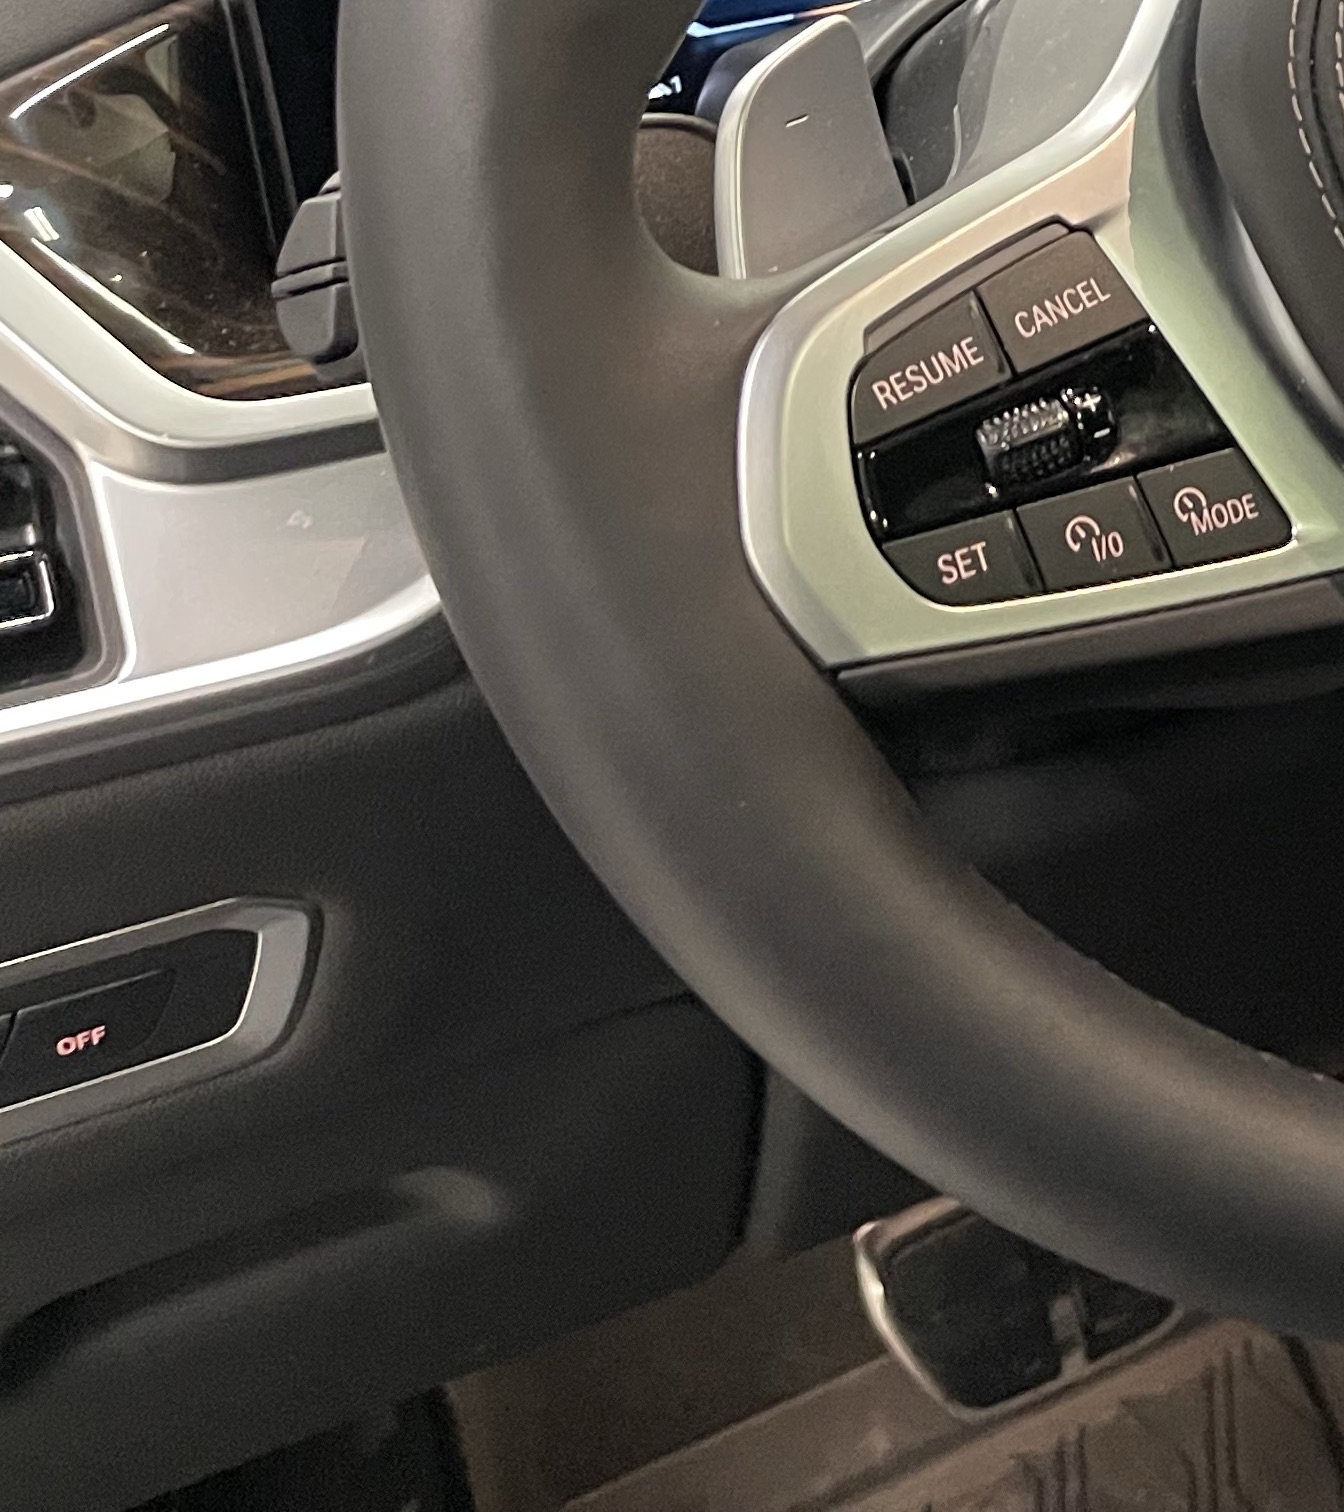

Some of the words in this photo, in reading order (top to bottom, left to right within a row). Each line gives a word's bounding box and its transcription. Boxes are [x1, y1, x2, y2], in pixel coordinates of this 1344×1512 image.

[1014, 277, 1112, 339] CANCEL
[872, 336, 985, 411] RESUME
[1190, 492, 1260, 537] MODE
[937, 542, 989, 585] SET
[56, 1024, 106, 1057] OFF
